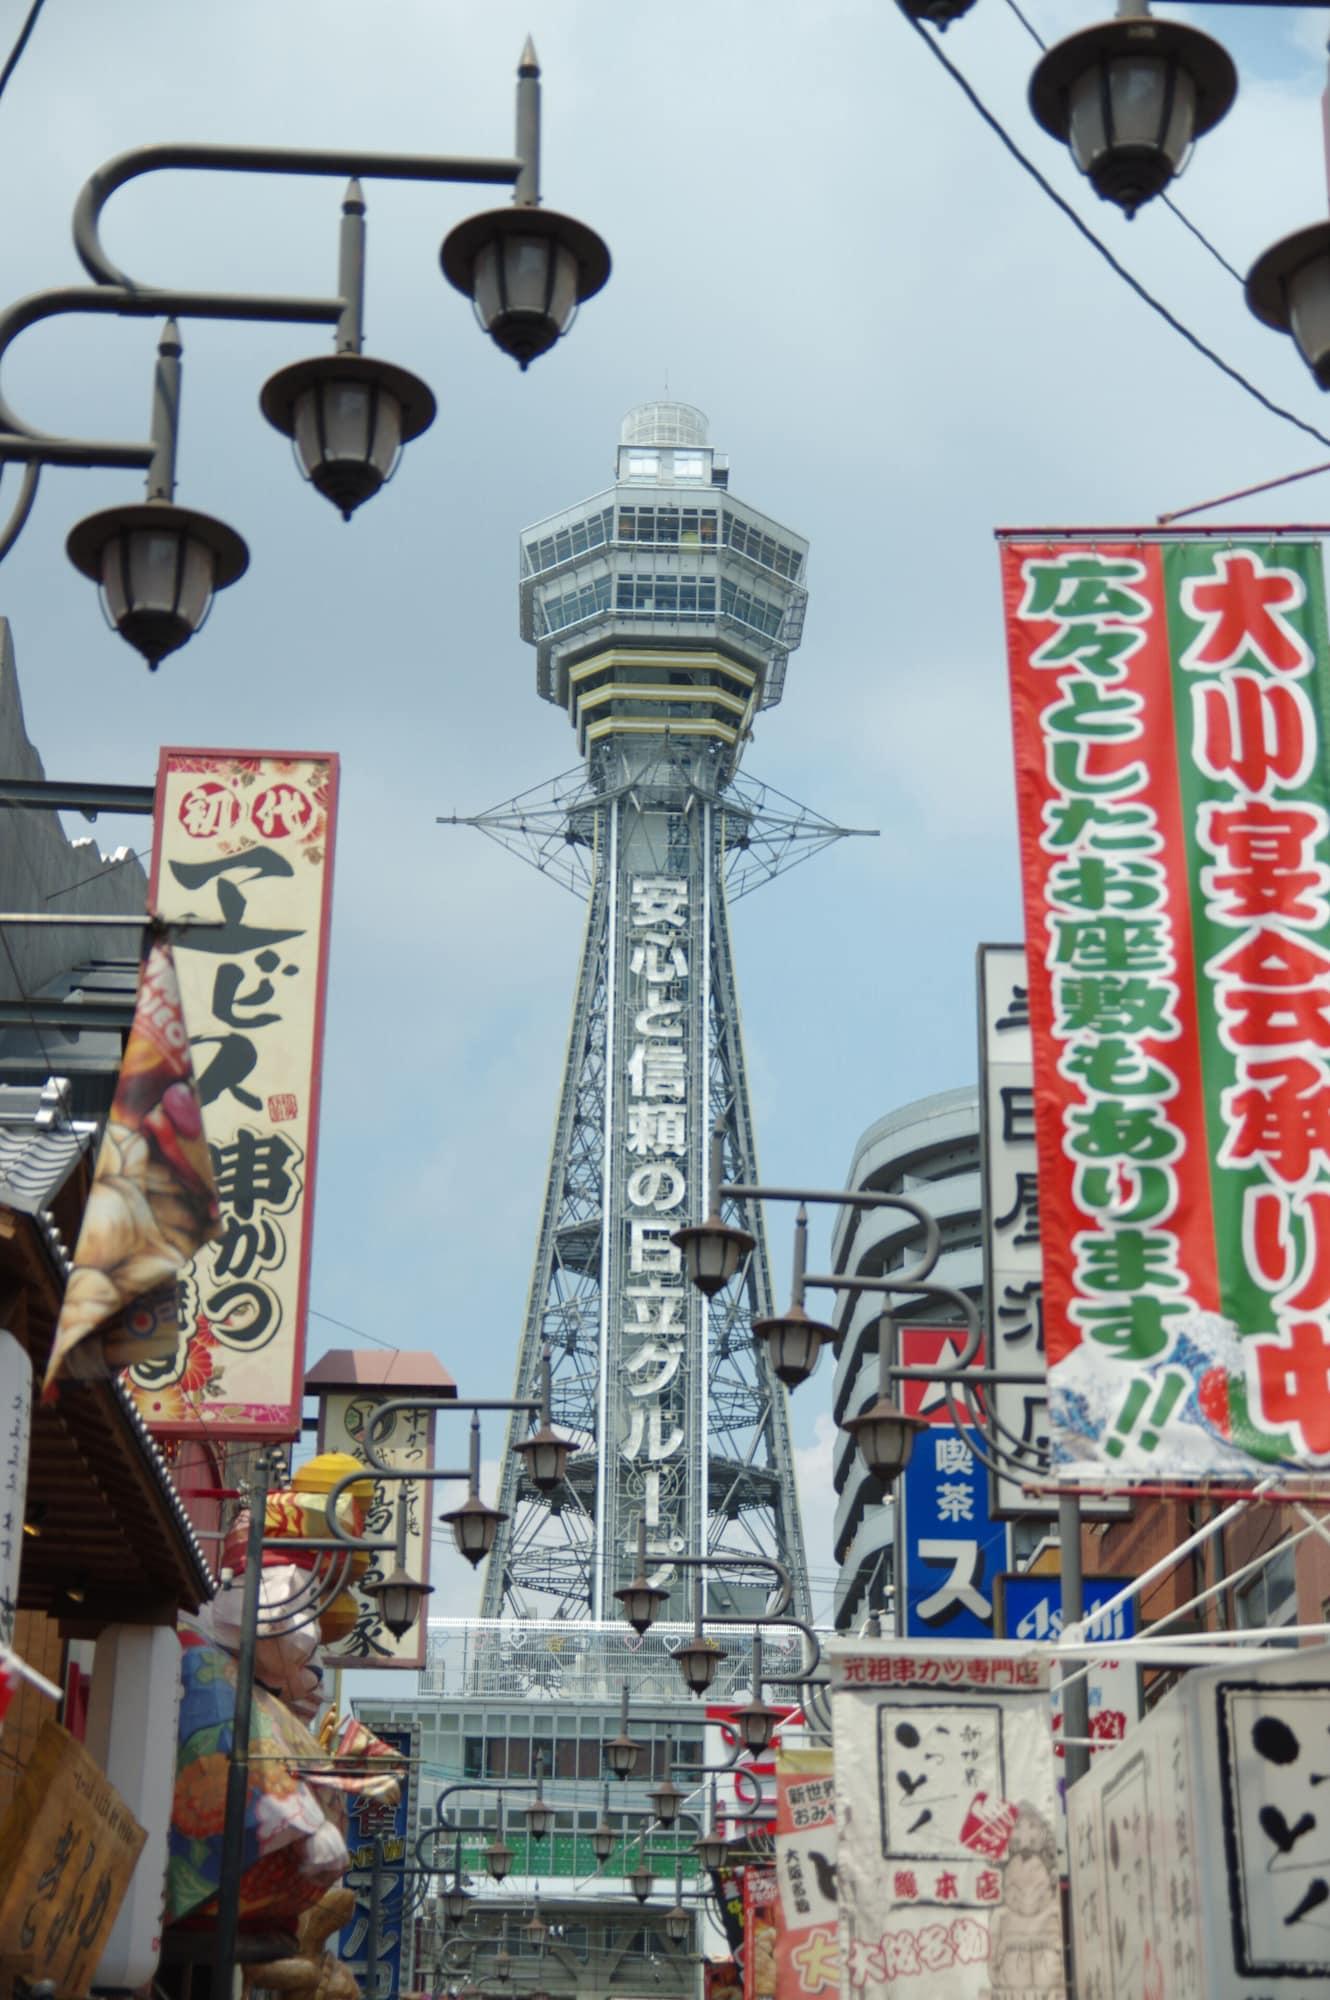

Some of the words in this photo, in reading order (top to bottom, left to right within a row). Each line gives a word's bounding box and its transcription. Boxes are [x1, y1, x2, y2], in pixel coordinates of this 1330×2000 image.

[183, 785, 312, 837] 初代
[168, 845, 307, 1112] エビス
[205, 1131, 298, 1346] 串かつ
[935, 1438, 974, 1522] 喫茶
[1015, 1596, 1125, 1640] Ashi
[843, 1657, 1040, 1685] 元祖串カツ専門店
